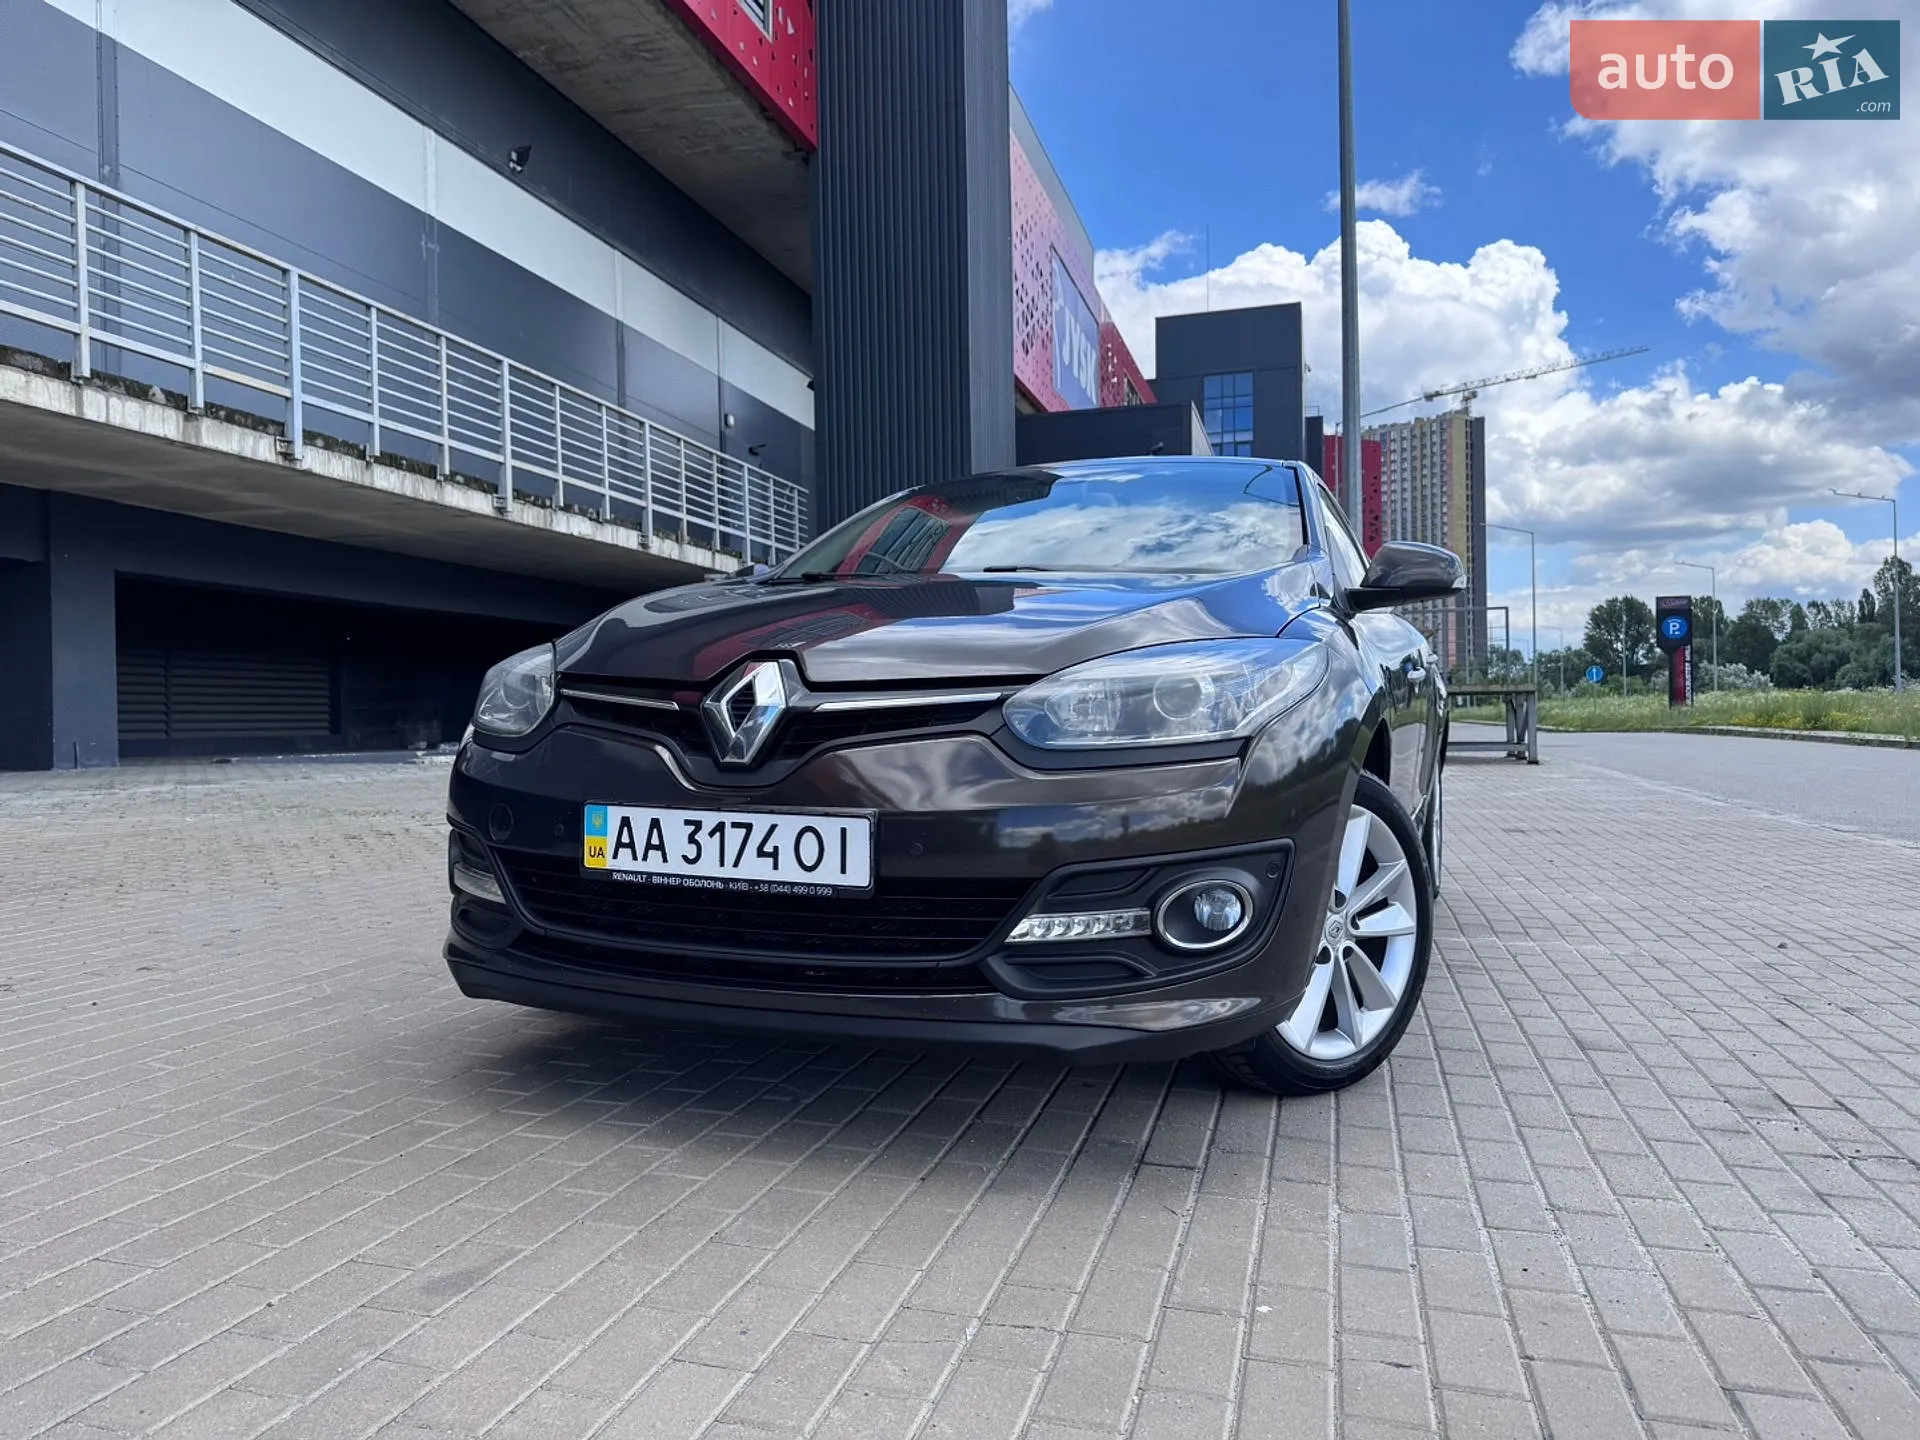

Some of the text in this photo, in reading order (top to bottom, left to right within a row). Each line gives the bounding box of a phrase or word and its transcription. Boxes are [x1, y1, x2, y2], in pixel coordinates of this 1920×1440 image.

[1063, 306, 1097, 404] JYSK
[589, 845, 605, 859] UA
[612, 815, 848, 875] AA 3174 OI
[611, 871, 648, 883] RENAULT
[682, 878, 724, 889] ОБОЛОНЬ
